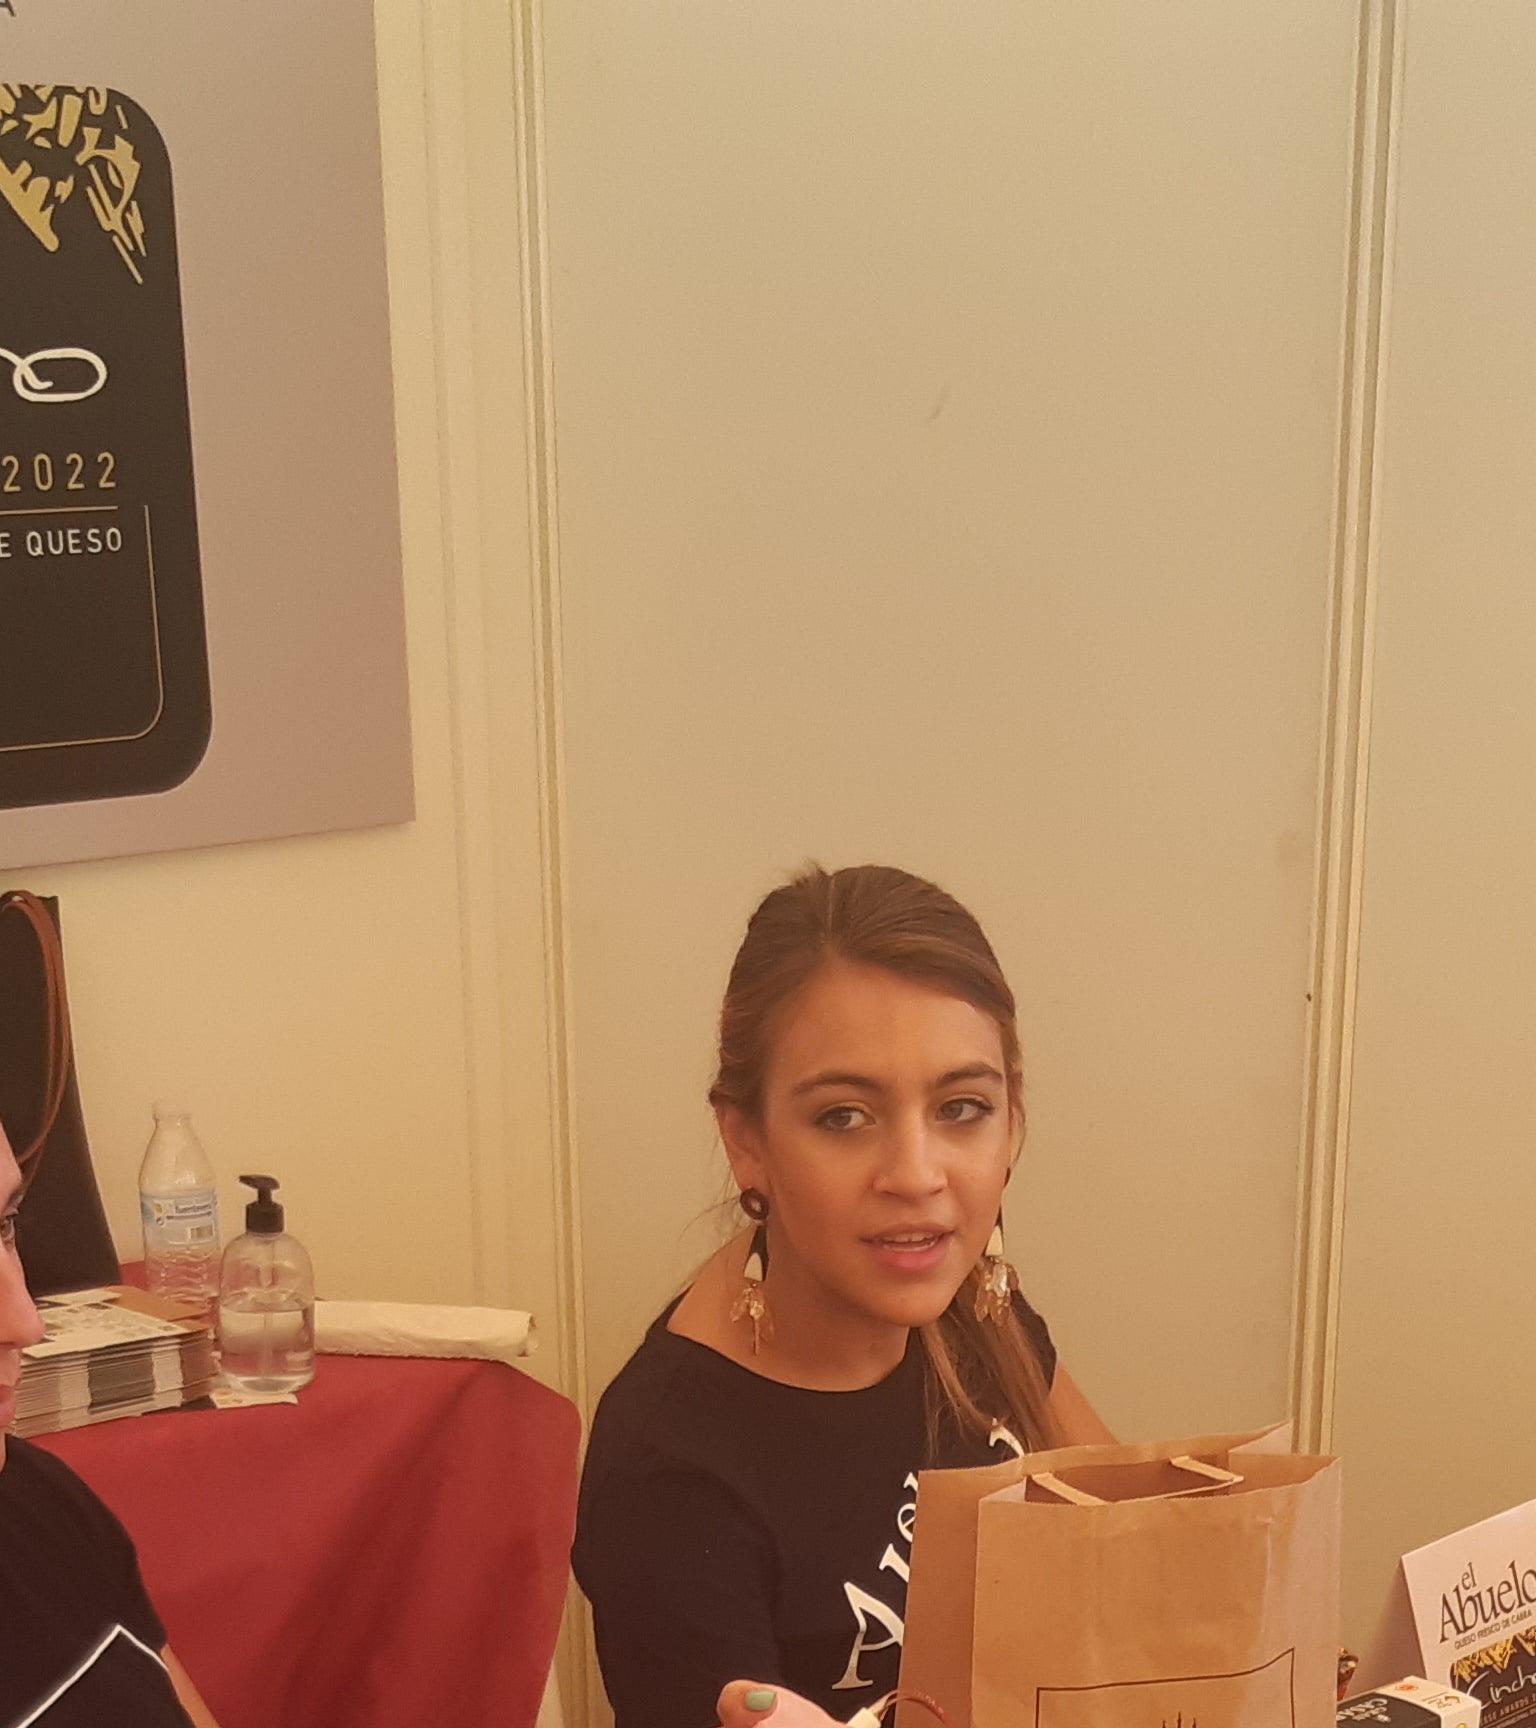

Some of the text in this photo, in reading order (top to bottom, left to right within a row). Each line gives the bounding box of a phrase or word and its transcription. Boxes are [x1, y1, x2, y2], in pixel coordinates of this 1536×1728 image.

[2, 451, 118, 493] 2022
[25, 526, 123, 557] QUESO
[1461, 1562, 1476, 1590] el
